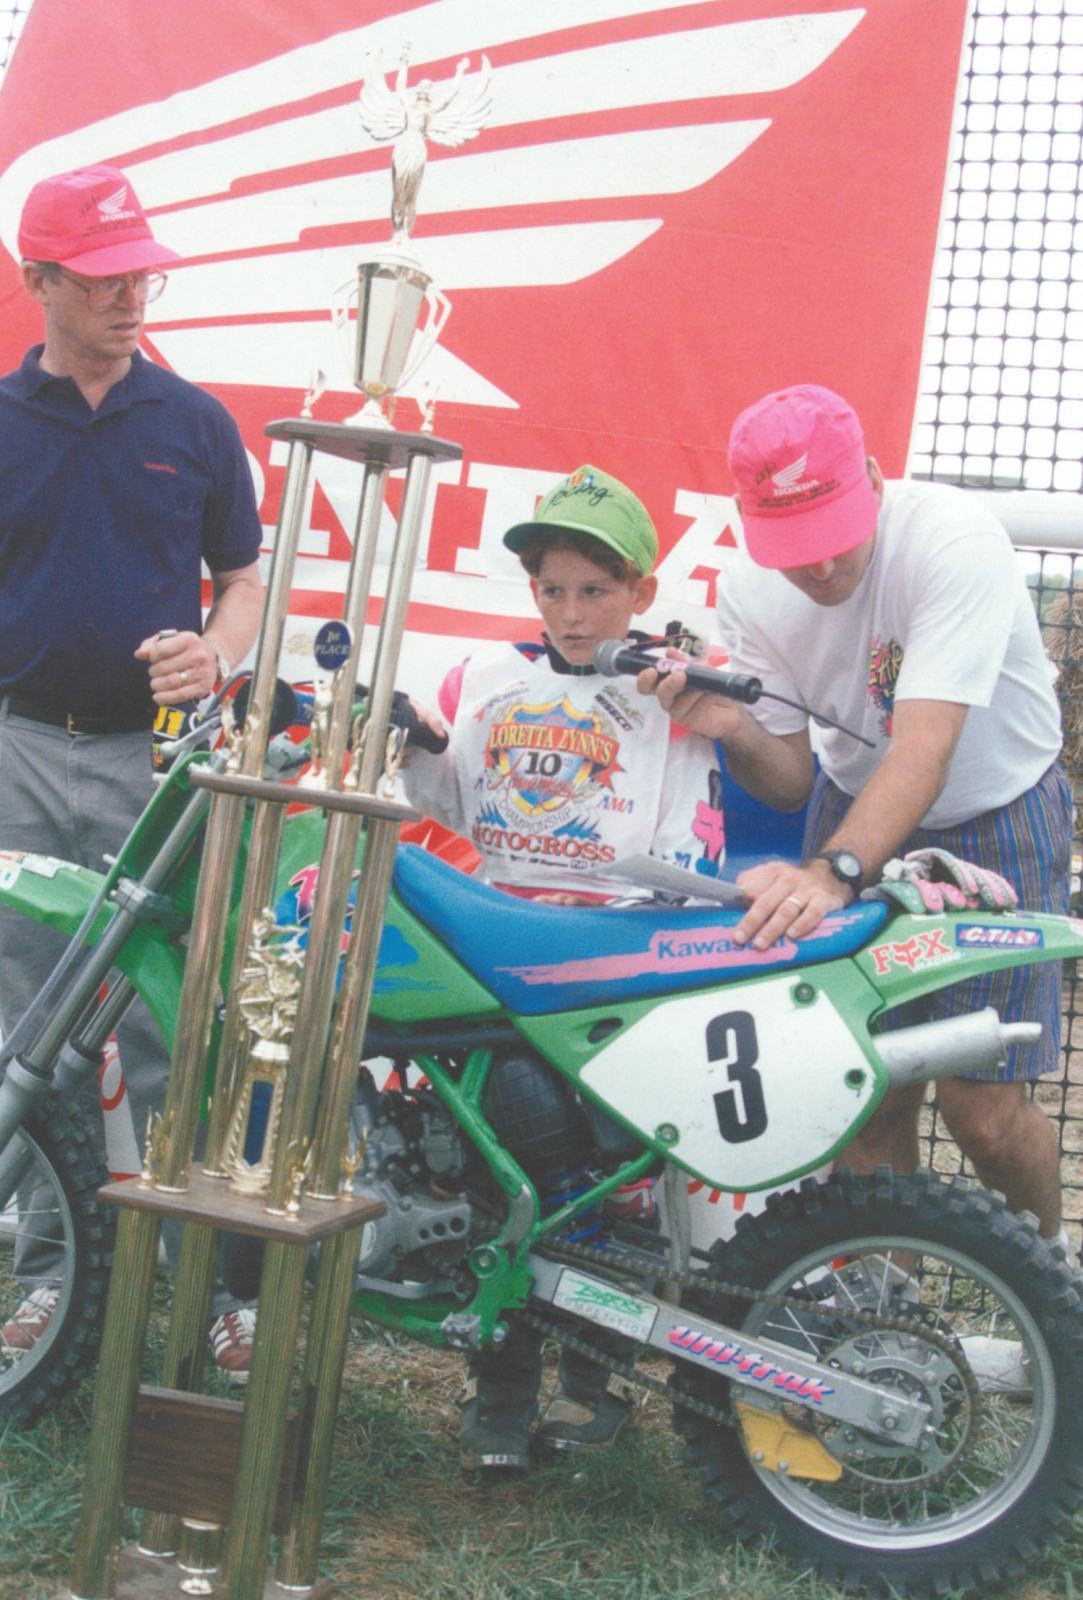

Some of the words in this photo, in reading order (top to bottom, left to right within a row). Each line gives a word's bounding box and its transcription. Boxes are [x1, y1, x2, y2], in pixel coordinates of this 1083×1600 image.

[99, 210, 137, 223] HONDA
[772, 479, 819, 497] HONDA
[314, 644, 350, 655] PLACE
[594, 693, 634, 732] WISECO
[490, 724, 554, 748] LORETTA
[557, 727, 613, 764] LYNN'S
[524, 752, 562, 777] 10
[499, 799, 572, 836] CHAMPIONSHIP
[597, 795, 635, 815] AMA
[471, 824, 616, 863] MOTOCROSS
[705, 1010, 768, 1145] 3
